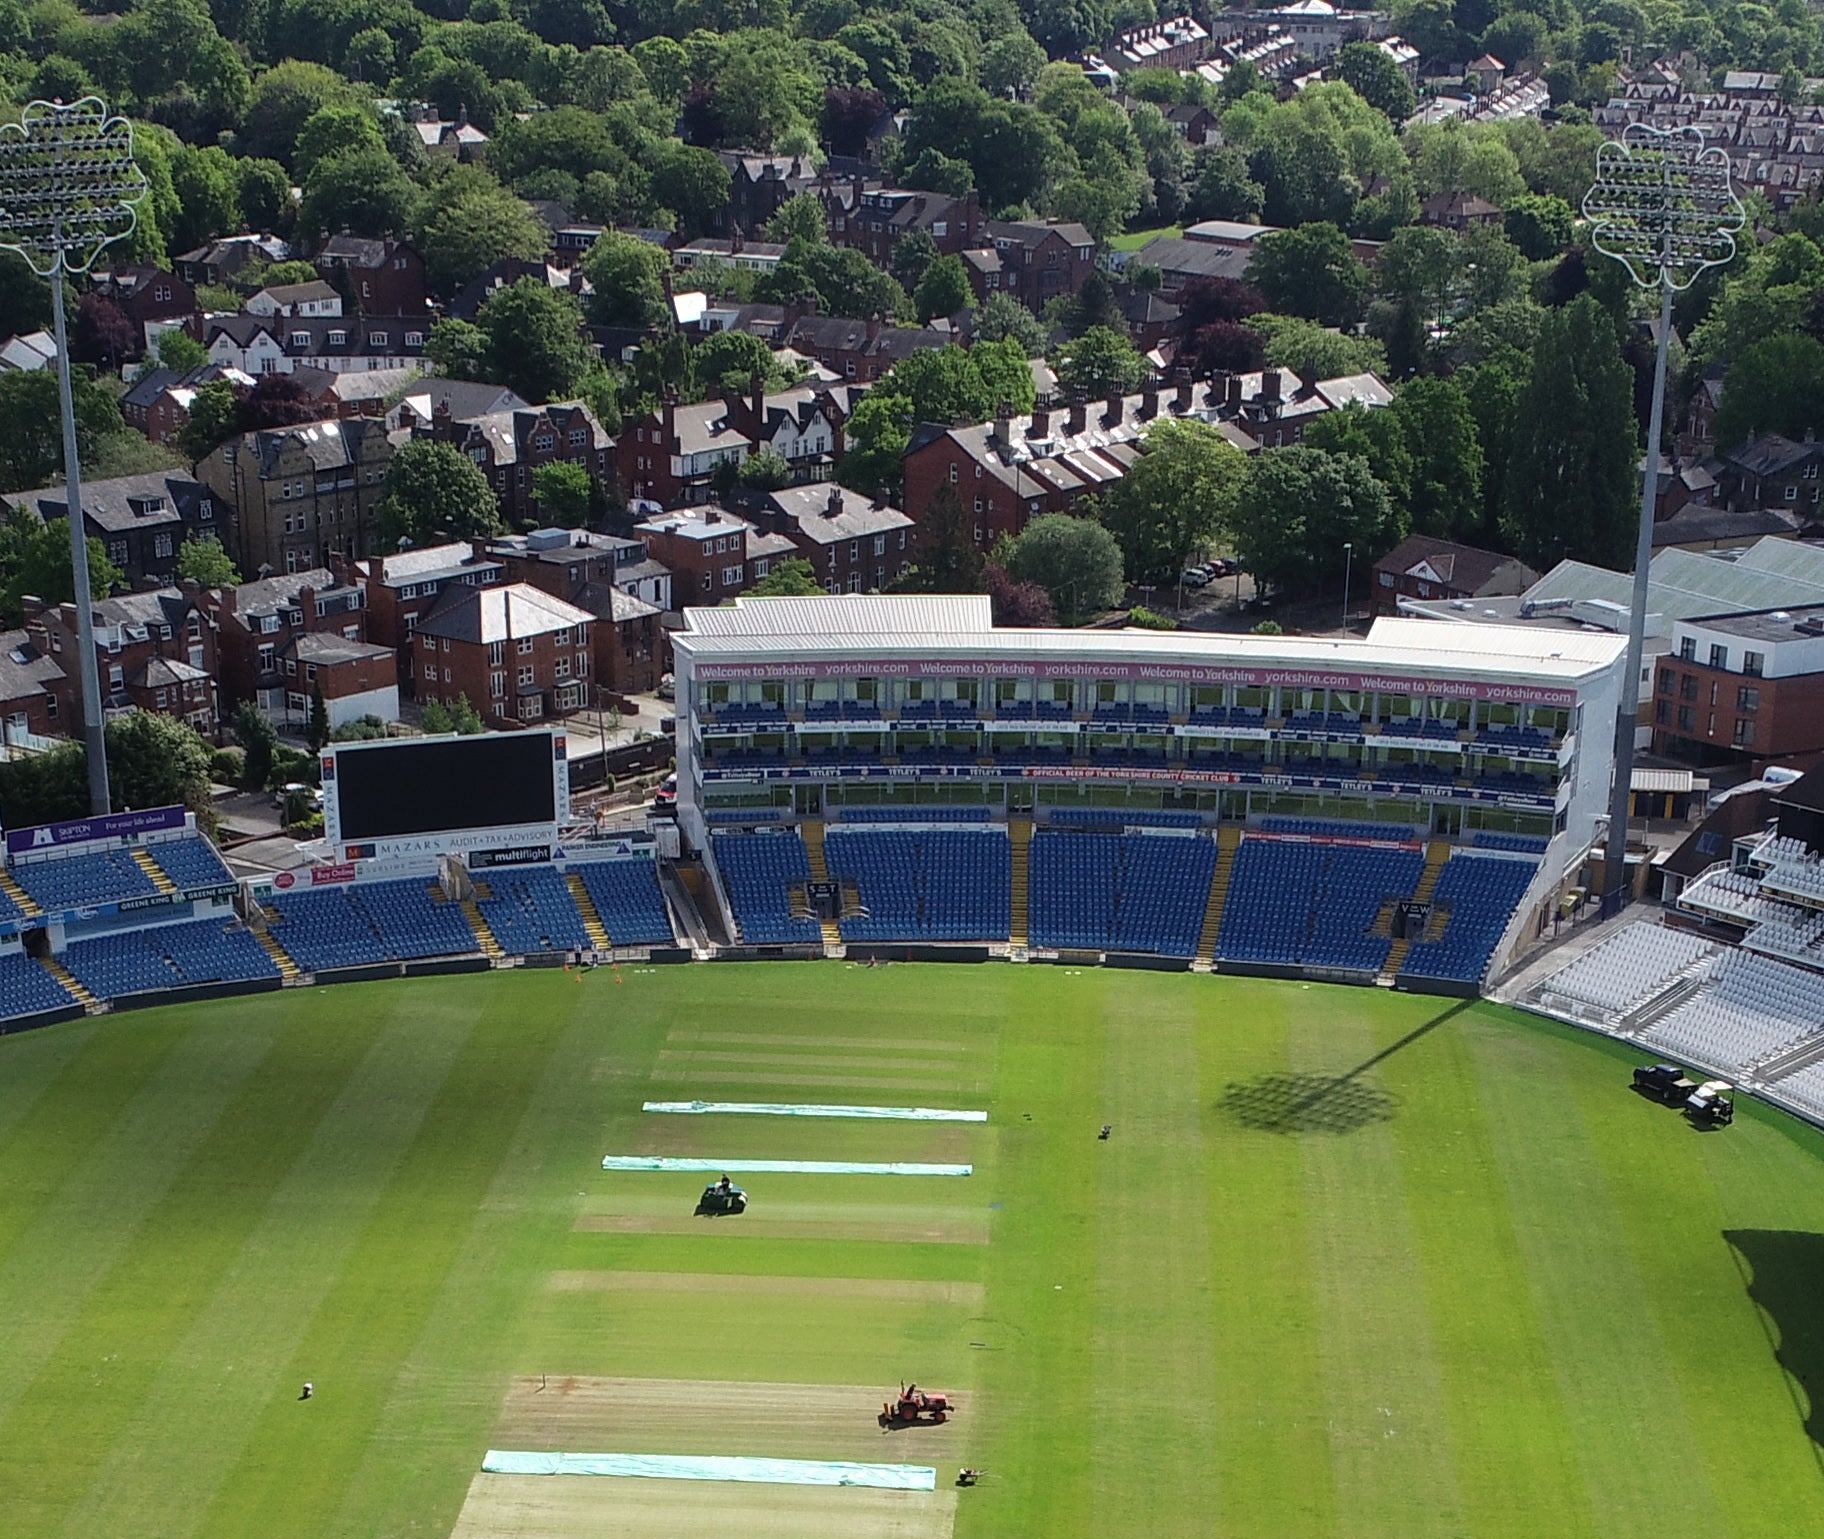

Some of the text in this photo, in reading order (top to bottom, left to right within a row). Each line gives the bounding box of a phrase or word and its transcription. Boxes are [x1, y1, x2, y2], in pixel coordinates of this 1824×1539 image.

[701, 664, 816, 677] Welcome to Yorkshire
[825, 663, 909, 675] yorkshire.com
[920, 662, 1035, 676] Welcome to Yorkshire
[1045, 664, 1129, 677] yorkshire.com
[1140, 666, 1255, 682] Welcome to Yorkshire
[1265, 671, 1349, 686] yorkshire.com
[1360, 677, 1476, 696] Welcome to Yorkshire
[1486, 686, 1571, 703] yorkshire.com
[809, 769, 841, 777] TETLEY'S
[888, 769, 920, 777] TETLEY'S
[969, 769, 1002, 777] TETLEY'S
[1033, 770, 1064, 778] OFFICIAL
[1065, 770, 1084, 778] BEER
[1085, 770, 1095, 778] OF
[1096, 770, 1109, 778] THE
[1111, 771, 1151, 779] YORKSHIRE
[1151, 772, 1180, 780] COUNTY
[1180, 773, 1210, 781] CRICKET
[1261, 777, 1293, 785] TETLEY'S
[1341, 782, 1373, 791] TETLEY'S
[556, 766, 567, 818] MAZARS
[1420, 788, 1453, 797] TETLEY'S
[326, 785, 337, 841] MAZARS
[105, 813, 166, 832] For your life ahead
[58, 824, 91, 836] SKIPTON
[381, 830, 553, 854] MAZARS AUDIT TAX ADVISORY
[494, 849, 549, 862] multiflight
[317, 871, 331, 879] Buy
[332, 868, 354, 878] Online
[121, 899, 149, 911] GREENE
[150, 896, 171, 907] KING
[188, 887, 215, 898] GREENE
[217, 884, 237, 895] KING
[1401, 904, 1430, 914] V W
